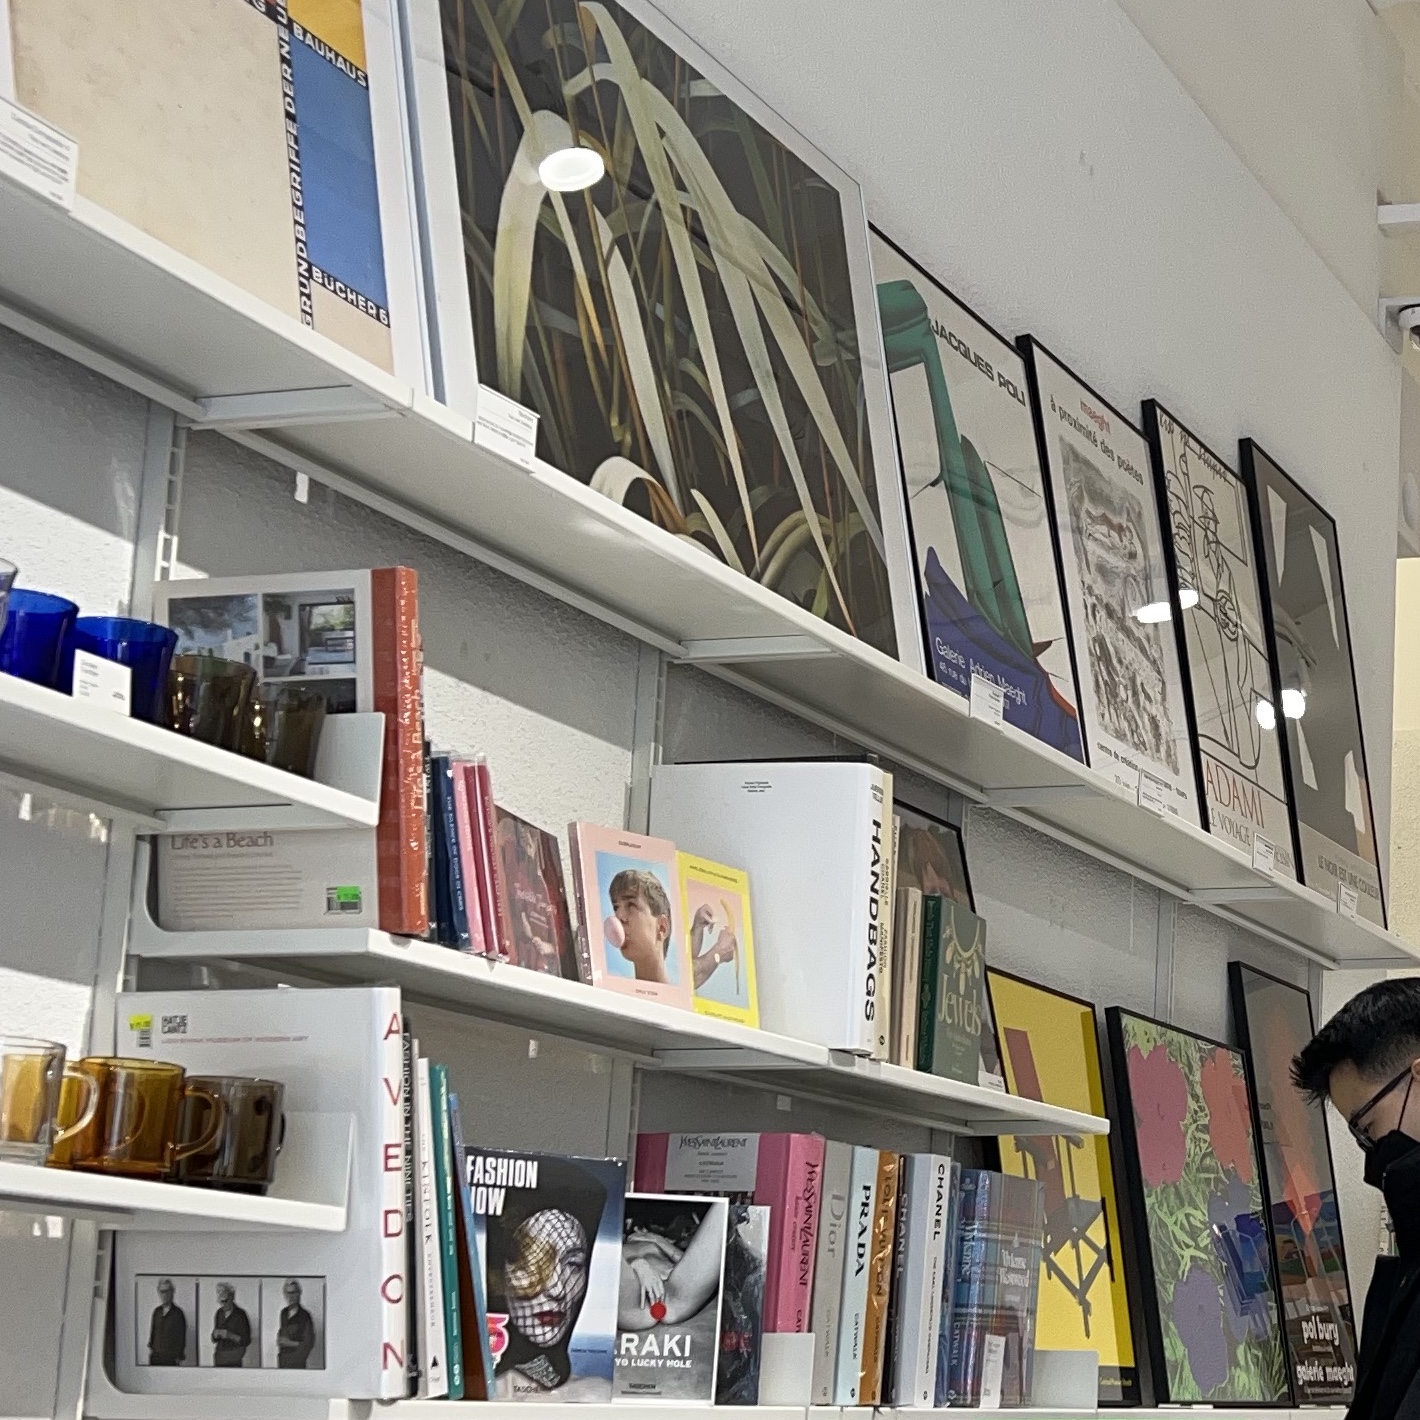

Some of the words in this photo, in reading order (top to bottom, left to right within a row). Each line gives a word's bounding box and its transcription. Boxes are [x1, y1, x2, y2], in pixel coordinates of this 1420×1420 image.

[275, 0, 292, 59] NEU
[293, 21, 368, 88] BAUHAUS
[281, 64, 297, 115] DER
[286, 121, 314, 330] GRUNDBEGRIFFE
[311, 264, 378, 320] BÜCHER
[379, 308, 390, 326] 6
[931, 319, 996, 383] JACQUES
[935, 636, 967, 670] Galerie
[1205, 759, 1265, 830] ADAMI
[171, 833, 210, 850] Life's
[226, 832, 274, 849] Beach
[864, 818, 882, 1023] HANDBAGS
[381, 1013, 404, 1371] AVEDON
[421, 1161, 433, 1245] KINFOLK
[466, 1155, 538, 1189] FASHION
[932, 1163, 946, 1241] CHANEL
[826, 1193, 846, 1260] Dior
[855, 1184, 872, 1279] PRADA
[896, 1193, 908, 1278] CHANEL
[615, 1333, 692, 1357] RAKI
[951, 1321, 961, 1366] CATWALK
[1301, 1315, 1317, 1345] pol
[1316, 1315, 1340, 1346] bury
[630, 1358, 664, 1368] LUCKY
[666, 1359, 692, 1368] HOLE
